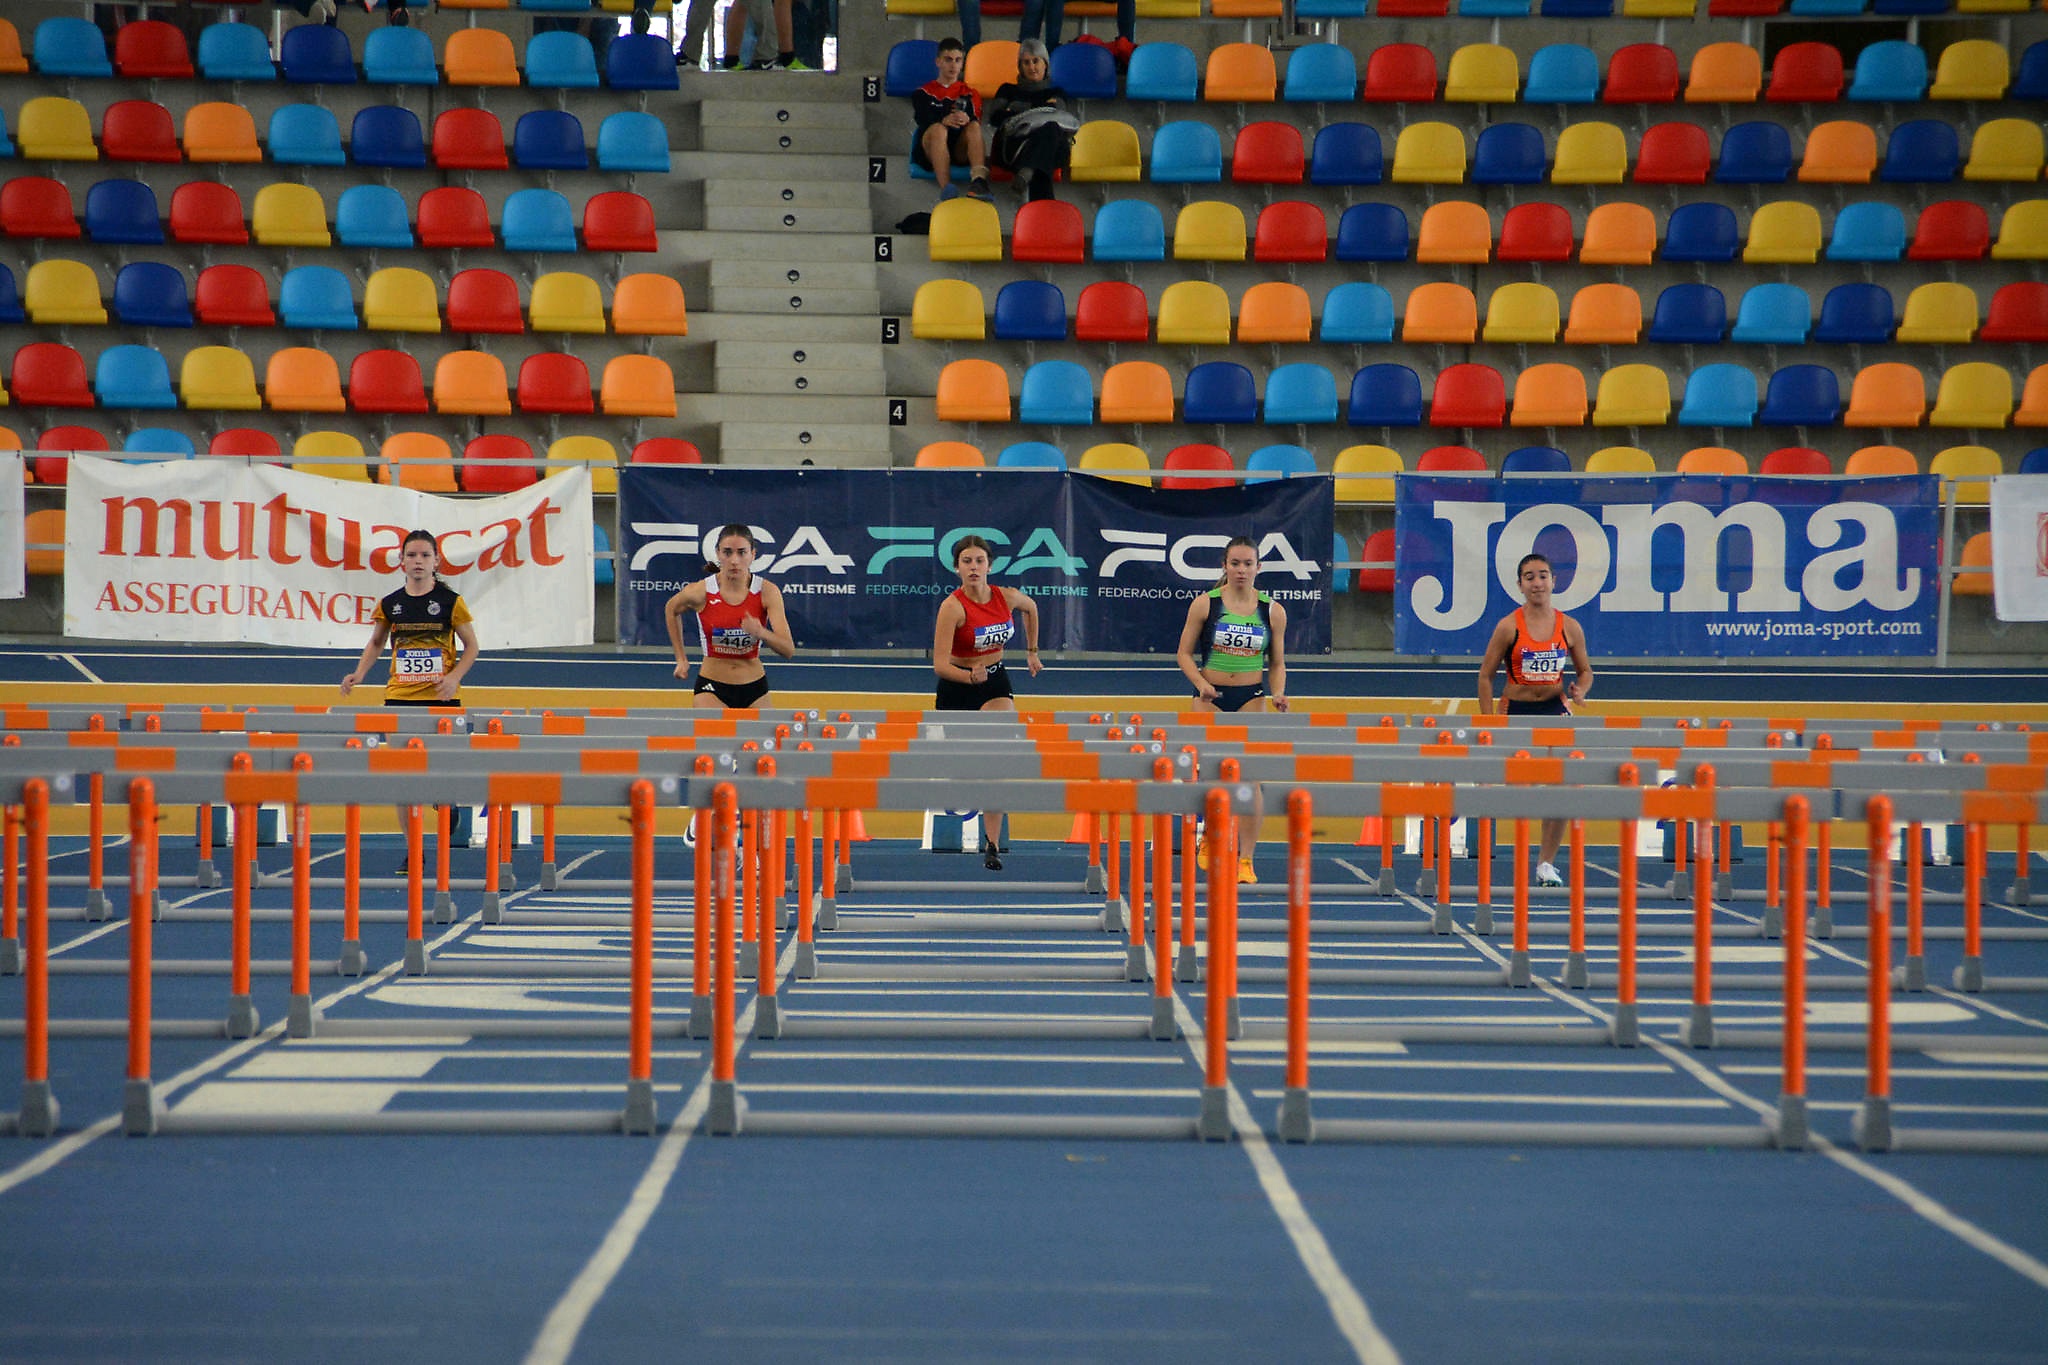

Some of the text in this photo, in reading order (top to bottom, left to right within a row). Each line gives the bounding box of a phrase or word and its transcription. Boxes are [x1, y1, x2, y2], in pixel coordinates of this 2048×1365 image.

[867, 83, 877, 97] 8
[872, 163, 882, 178] 7
[878, 242, 889, 257] 6
[885, 324, 896, 338] 5
[892, 405, 904, 420] 4
[98, 492, 565, 576] mutuacat
[629, 522, 856, 575] FCA
[866, 526, 1089, 576] FCA
[1099, 529, 1321, 580] FCA
[1411, 501, 1921, 631] Joma
[782, 583, 857, 595] ATLETISME
[866, 582, 942, 596] FEDERACIÓ
[1019, 585, 1089, 597] ATLETISME
[1098, 586, 1172, 600] FEDERACIÓ
[1705, 618, 1922, 641] www.joma-sport.com
[720, 636, 751, 648] 446
[982, 631, 1009, 646] 408
[1222, 633, 1253, 649] 361
[403, 658, 434, 673] 359
[1529, 659, 1558, 672] 401
